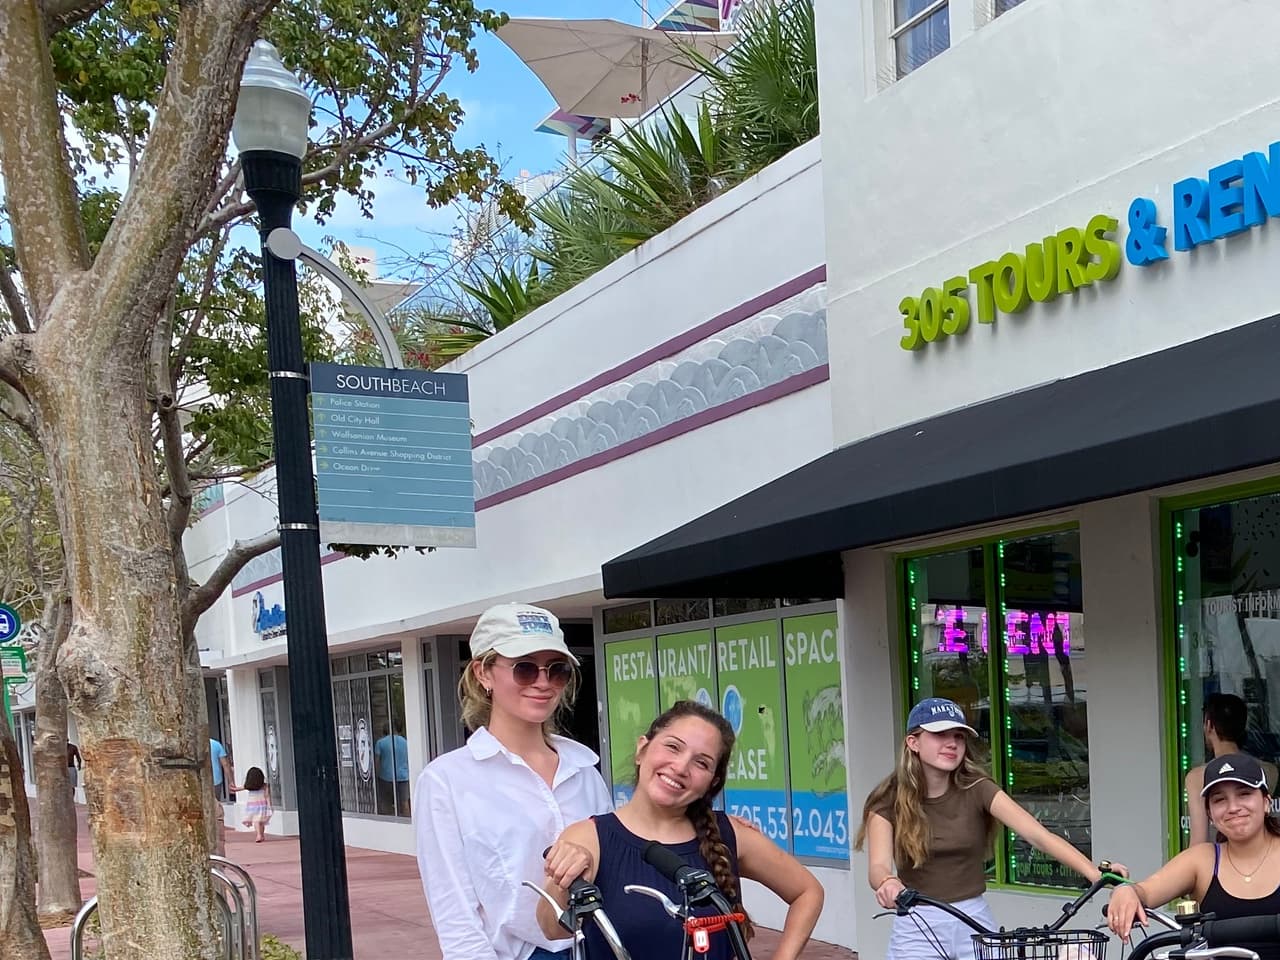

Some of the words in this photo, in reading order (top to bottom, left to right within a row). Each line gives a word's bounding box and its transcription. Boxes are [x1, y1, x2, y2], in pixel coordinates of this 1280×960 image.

[900, 276, 970, 351] 305
[969, 214, 1122, 324] TOURS
[1126, 197, 1168, 267] &
[330, 399, 352, 408] Police
[354, 400, 380, 409] Station
[331, 414, 346, 422] Old
[348, 415, 363, 425] City
[364, 416, 380, 425] Hall
[376, 434, 408, 442] Museum
[332, 446, 358, 456] Collins
[360, 448, 388, 458] Avenue
[389, 450, 425, 461] Shopping
[426, 452, 452, 461] District
[332, 462, 359, 471] Ocean
[1207, 598, 1242, 616] TOURIST
[727, 748, 768, 780] EASE
